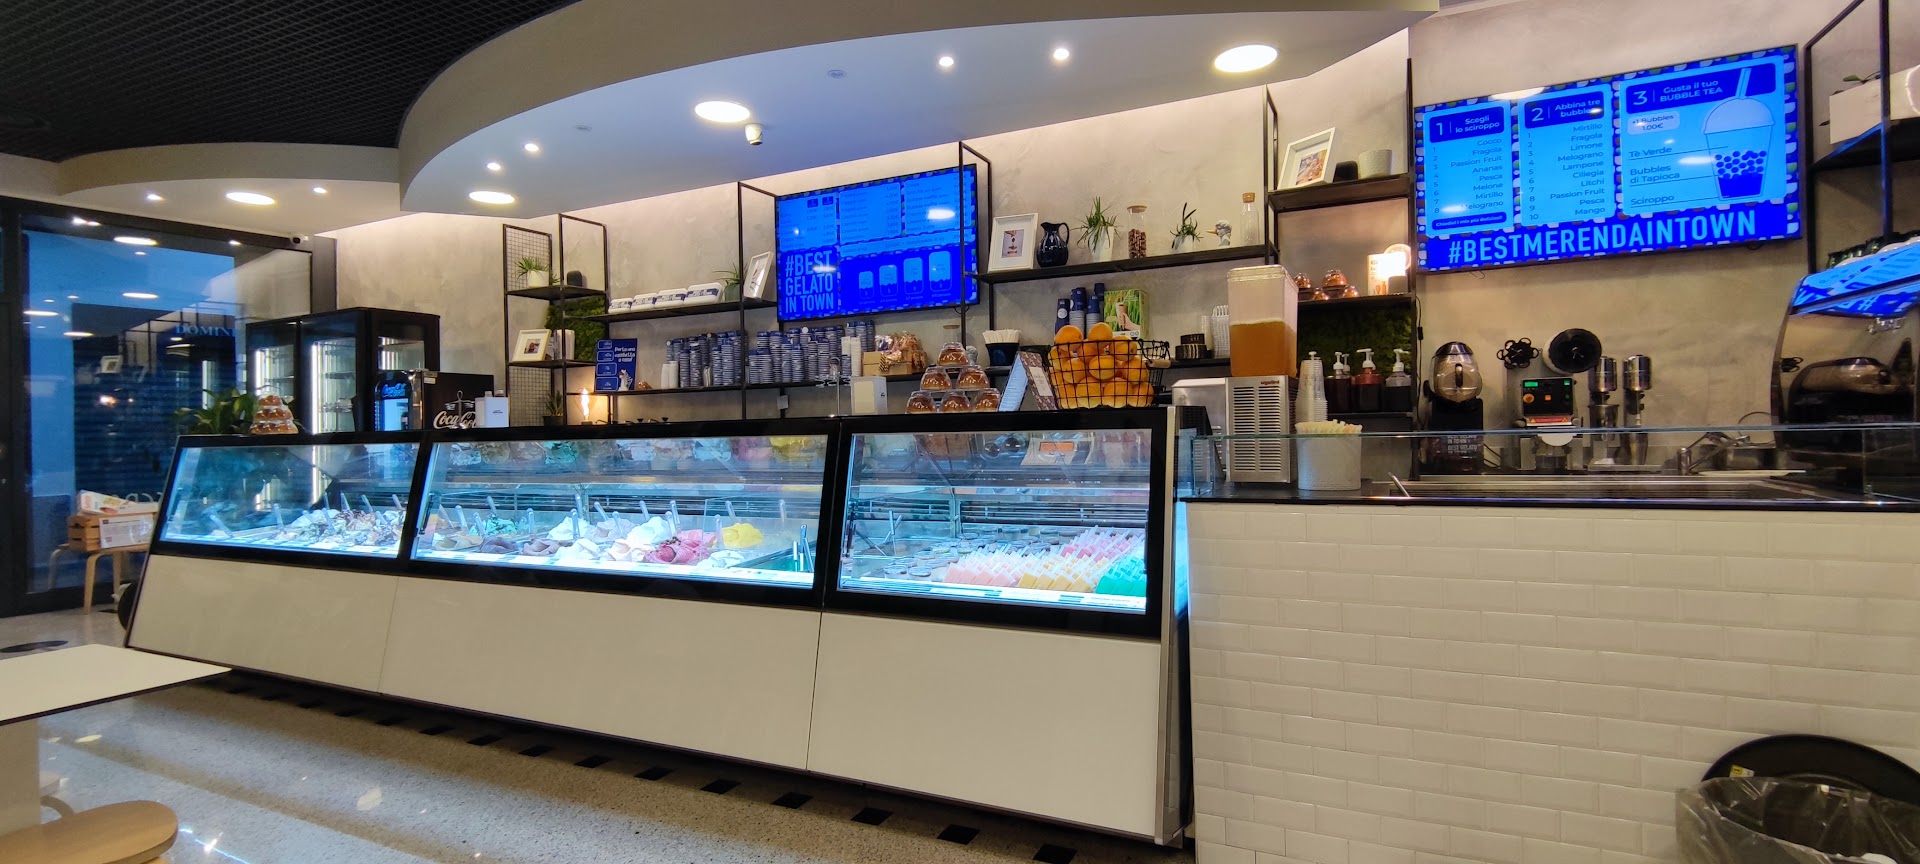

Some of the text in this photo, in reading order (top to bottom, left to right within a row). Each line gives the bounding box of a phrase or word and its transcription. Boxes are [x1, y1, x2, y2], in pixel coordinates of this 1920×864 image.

[1660, 87, 1723, 102] BUBBLE TEA
[1663, 85, 1691, 94] Gusta
[1633, 91, 1647, 105] 3
[1555, 102, 1586, 111] Abbina
[1532, 108, 1544, 122] 2
[1560, 108, 1594, 118] bubble
[1464, 115, 1490, 125] Scegli
[1436, 122, 1442, 136] 1
[1464, 122, 1500, 132] sciroppo
[1573, 124, 1602, 132] Mirtillo
[1477, 138, 1502, 146] Cocco
[1571, 132, 1602, 142] Fragola
[1472, 147, 1502, 156] Fragola
[1570, 142, 1603, 151] Limone
[1642, 147, 1672, 156] Verde
[1558, 151, 1604, 162] Melograno
[1451, 158, 1480, 168] Passion
[1562, 160, 1604, 171] Lampone
[1472, 164, 1502, 174] Ananas
[1630, 165, 1671, 176] Bubbles
[1572, 170, 1604, 179] Ciliegia
[1630, 173, 1680, 184] di Tapioca
[1474, 182, 1503, 191] Melone
[1581, 178, 1604, 186] Litchi
[1476, 191, 1504, 200] Mirtillo
[1550, 190, 1582, 199] Passion
[1461, 200, 1504, 210] elograno
[1580, 198, 1604, 206] Pesca
[1630, 196, 1674, 206] Sciroppo
[1575, 206, 1606, 216] Mango
[1449, 210, 1756, 264] #BESTMERENDAINTOWN
[785, 250, 832, 278] #BEST
[786, 273, 833, 296] GELATO
[786, 292, 834, 313] IN TOWN
